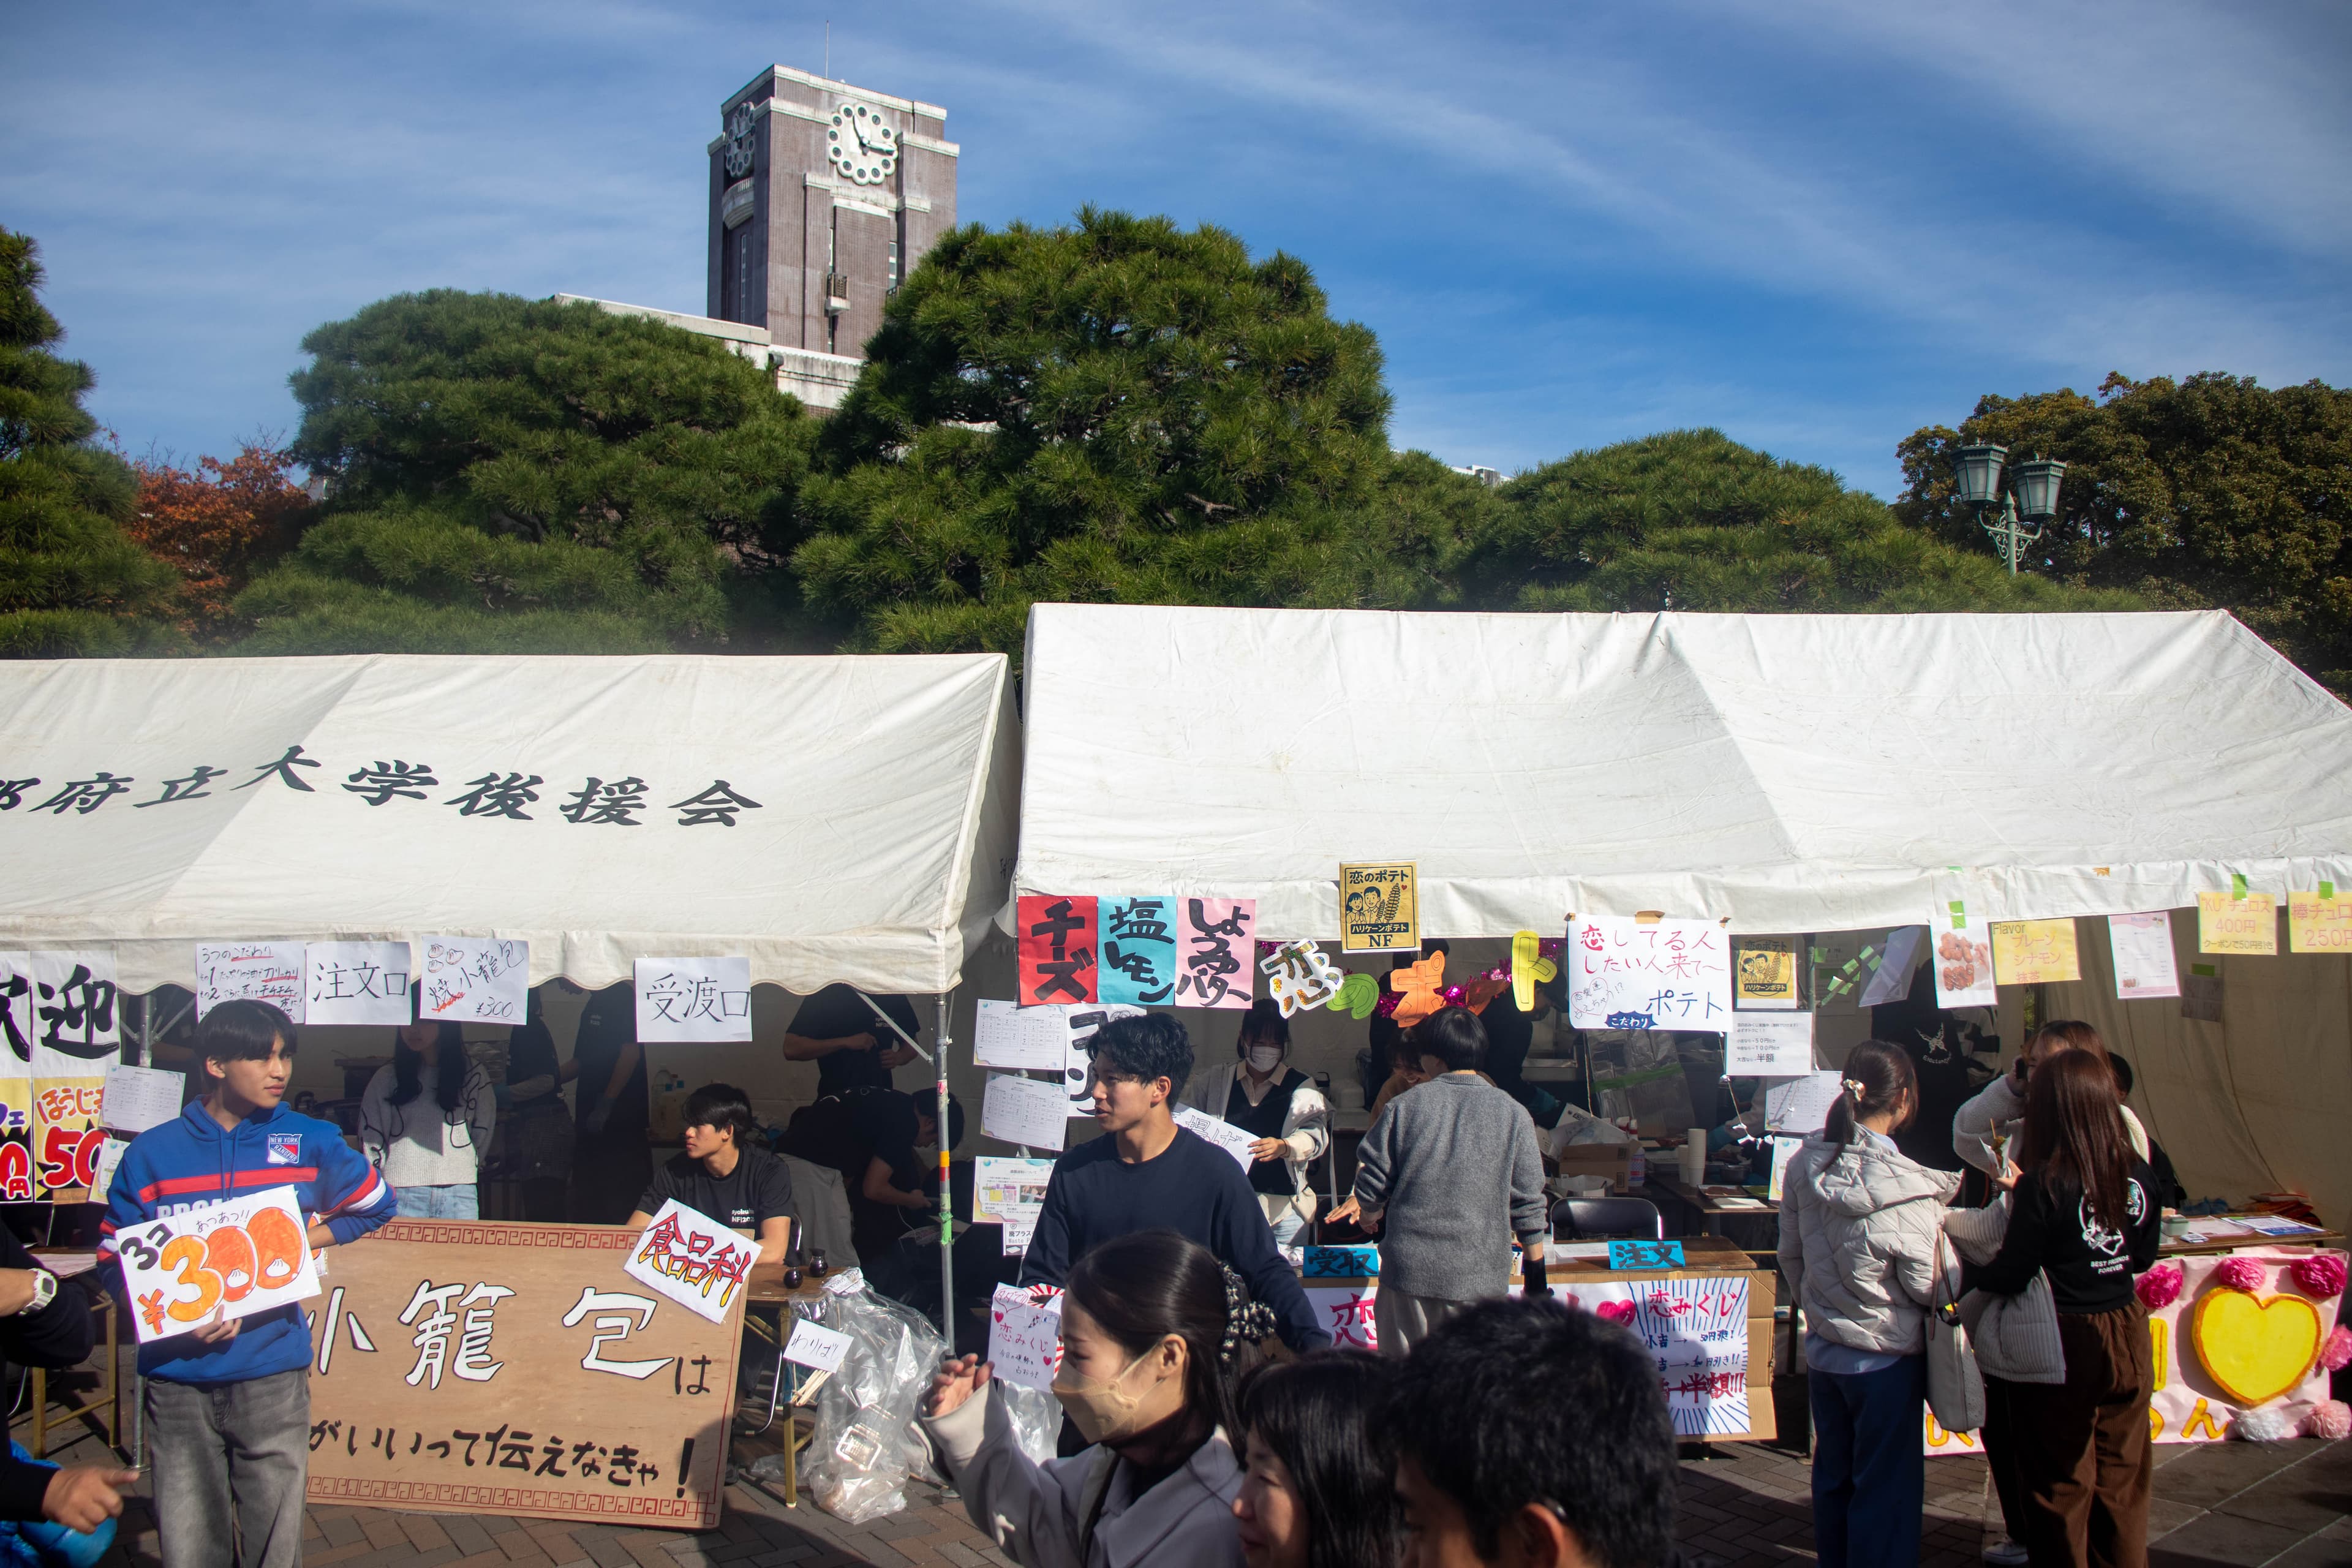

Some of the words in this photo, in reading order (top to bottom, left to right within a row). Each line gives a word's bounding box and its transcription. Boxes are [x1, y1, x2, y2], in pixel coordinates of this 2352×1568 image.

[1349, 869, 1409, 884] 恋のポテト
[2228, 900, 2271, 913] チュロス
[1351, 924, 1407, 933] ハリケーンポテト
[1992, 922, 2026, 935] Flavor
[2215, 919, 2256, 933] 400円
[1368, 934, 1393, 948] NF
[1580, 924, 1716, 952] 恋してる人
[1744, 940, 1787, 951] 恋のポテト
[2011, 933, 2056, 948] プレーン
[2204, 940, 2274, 950] クーポンで50円引き
[1031, 900, 1096, 1002] チーズ
[2014, 951, 2062, 967] シナモン
[312, 962, 407, 1002] 注文口
[1259, 930, 1558, 1028] 恋のポト
[475, 996, 514, 1017] ¥300
[646, 973, 751, 1023] 受渡口
[1645, 989, 1724, 1019] ポテト
[1610, 1016, 1648, 1028] こだわり
[1170, 1111, 1243, 1148] 揚げ
[274, 1144, 298, 1161] RANGERS
[196, 1210, 251, 1233] あつあつ!!
[120, 1223, 175, 1271] 3コ
[1615, 1242, 1684, 1268] 注文
[137, 1206, 306, 1335] ¥300
[638, 1211, 752, 1308] 食品科
[1308, 1248, 1378, 1275] 受取
[2090, 1259, 2108, 1268] BEST
[2108, 1254, 2130, 1265] FRIENDS
[2097, 1263, 2124, 1275] FOREVER
[1647, 1288, 1738, 1318] 恋みくじ
[791, 1333, 839, 1363] わりばし
[998, 1322, 1049, 1352] 恋みくじ
[1646, 1333, 1669, 1349] 小吉
[1657, 1357, 1668, 1372] 吉
[308, 1419, 695, 1499] がいいって伝えなきゃ!
